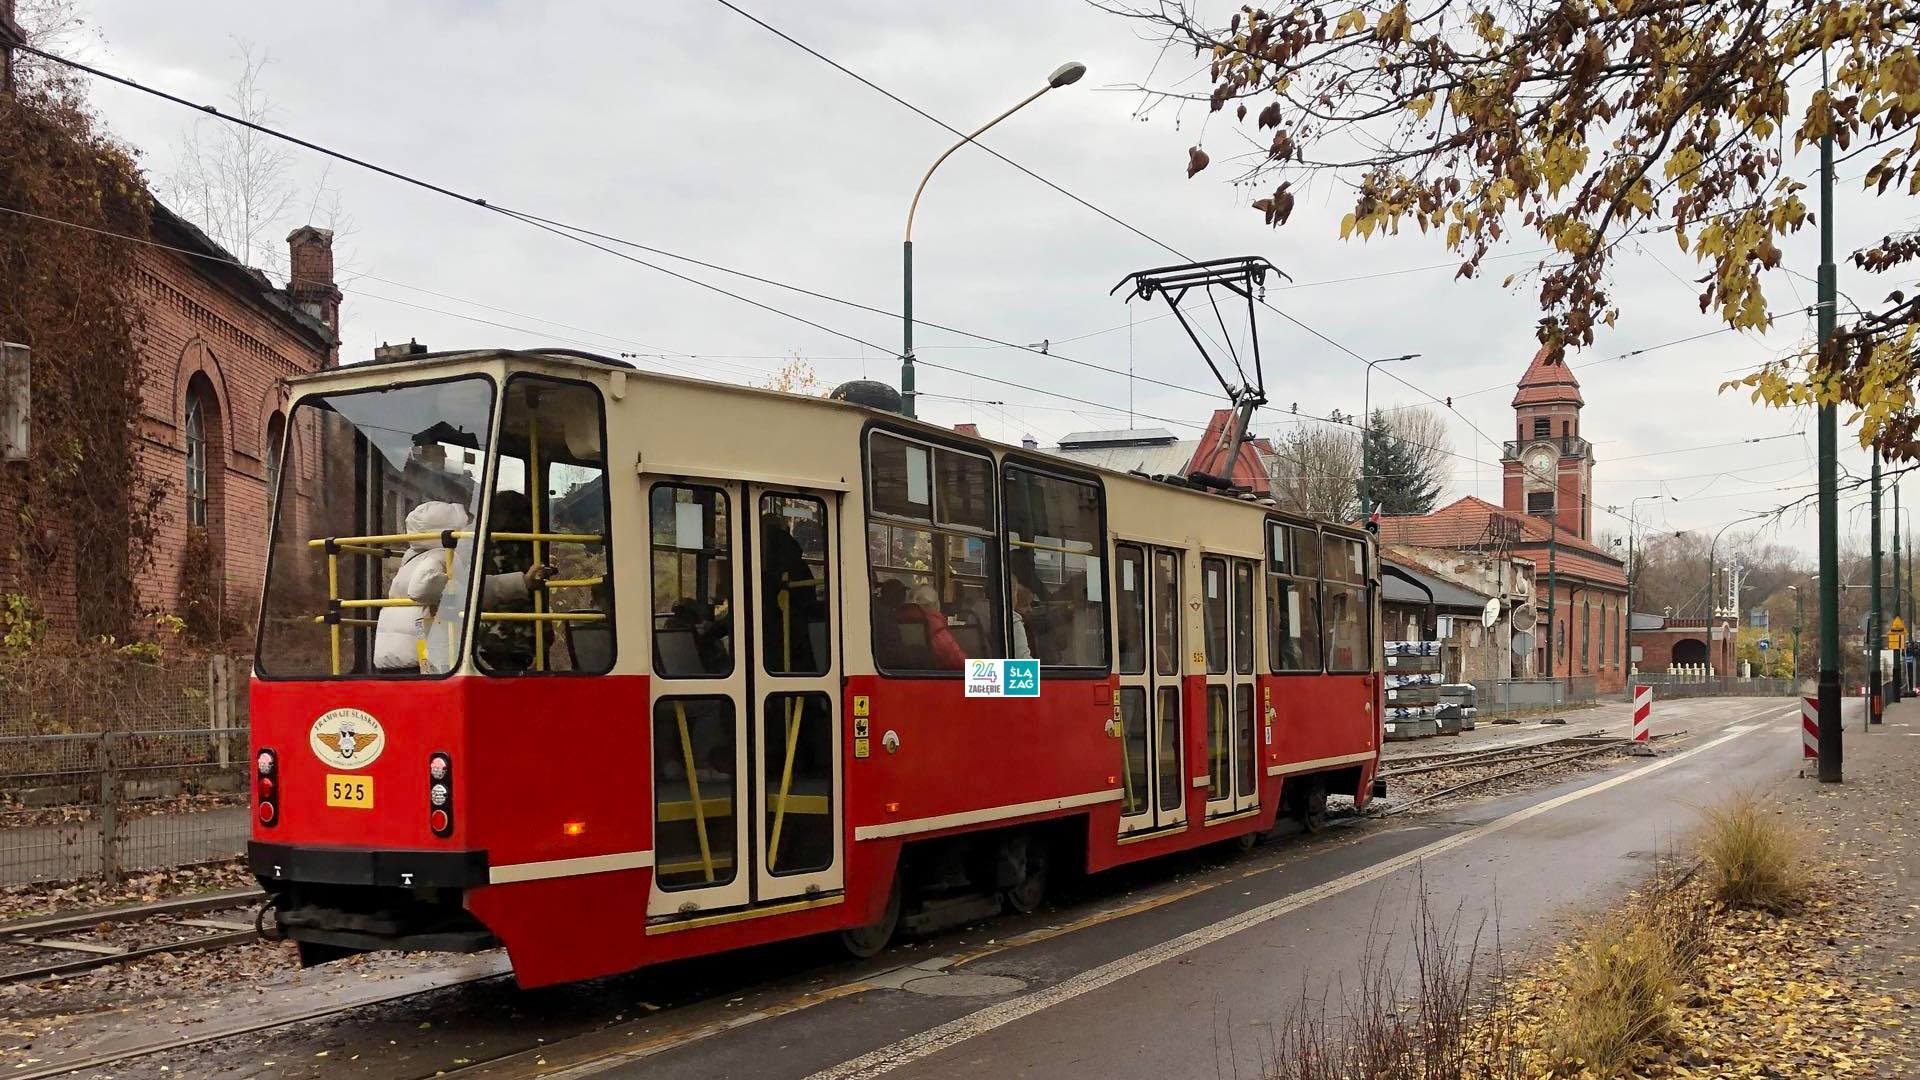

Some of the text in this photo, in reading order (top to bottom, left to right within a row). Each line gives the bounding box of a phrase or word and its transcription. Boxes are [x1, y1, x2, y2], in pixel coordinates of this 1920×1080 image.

[1193, 652, 1204, 663] 525
[314, 709, 349, 731] TRAMWAJE
[333, 782, 364, 801] 525
